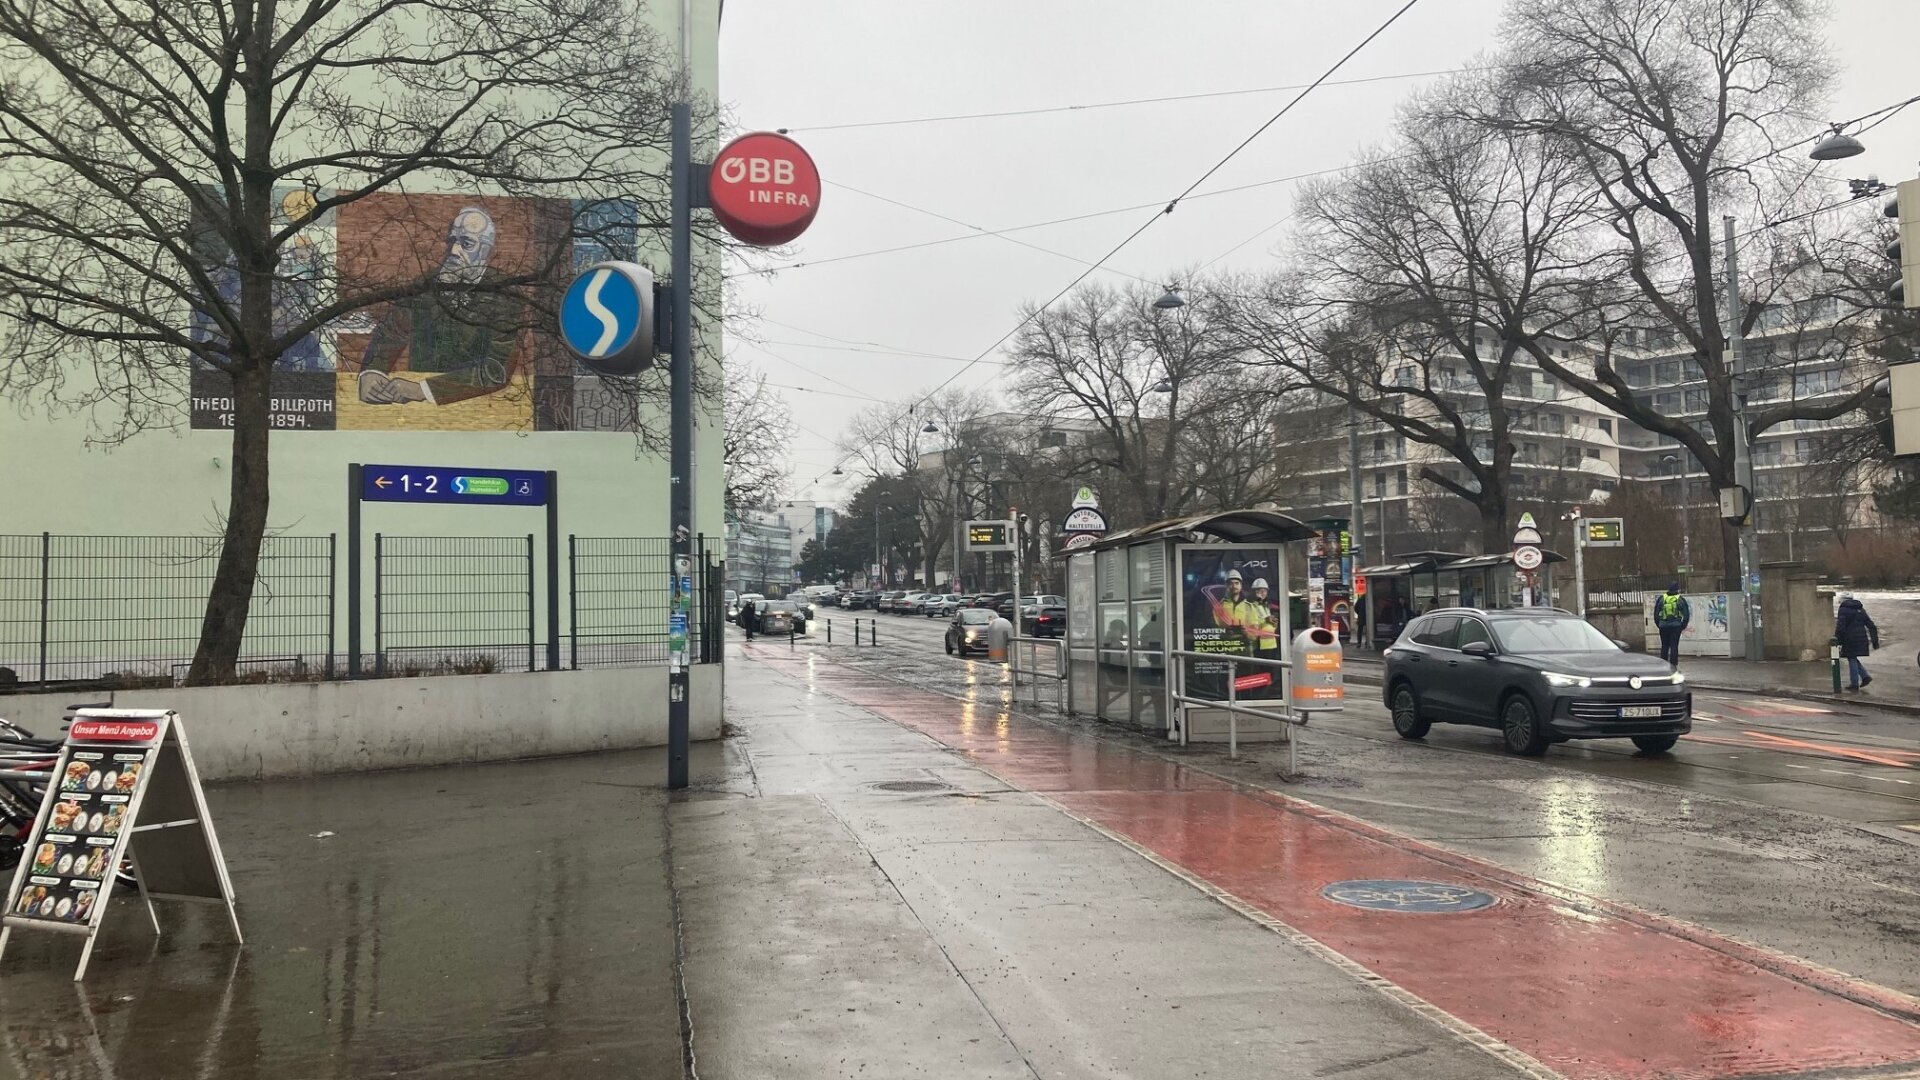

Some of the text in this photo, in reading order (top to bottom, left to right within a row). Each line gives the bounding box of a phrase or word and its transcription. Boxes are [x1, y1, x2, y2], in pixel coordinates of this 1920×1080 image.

[721, 157, 794, 184] ÖBB
[749, 190, 810, 207] INFRA
[192, 398, 332, 412] THEO BILLROTH
[400, 474, 438, 494] 1-2
[1073, 511, 1098, 520] AUTOBUS
[74, 725, 155, 738] Unser Menü Angebot
